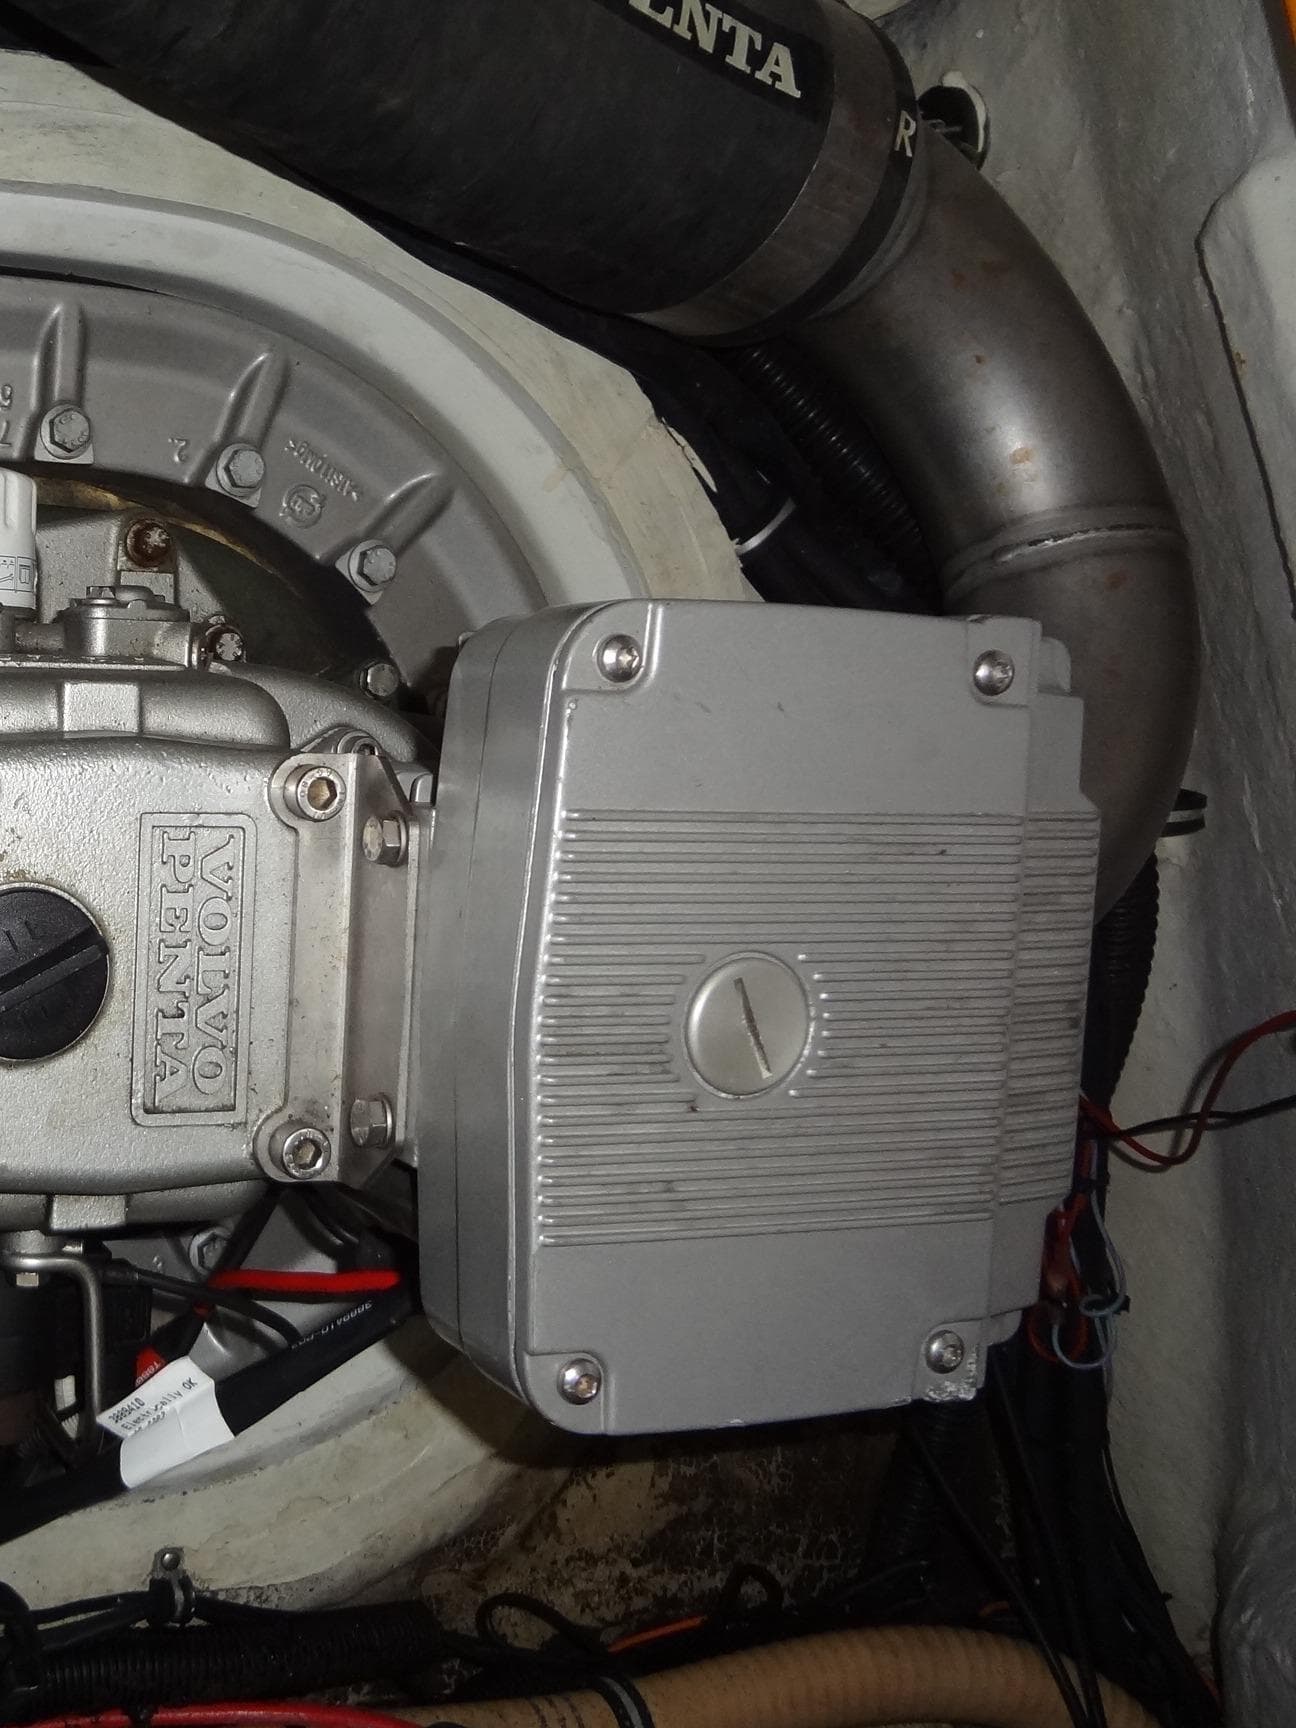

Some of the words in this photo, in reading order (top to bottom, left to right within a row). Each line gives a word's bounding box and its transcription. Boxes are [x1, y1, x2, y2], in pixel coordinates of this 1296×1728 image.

[154, 831, 197, 1108] PENTA
[192, 833, 236, 1096] VOLVO
[182, 1376, 198, 1391] OK
